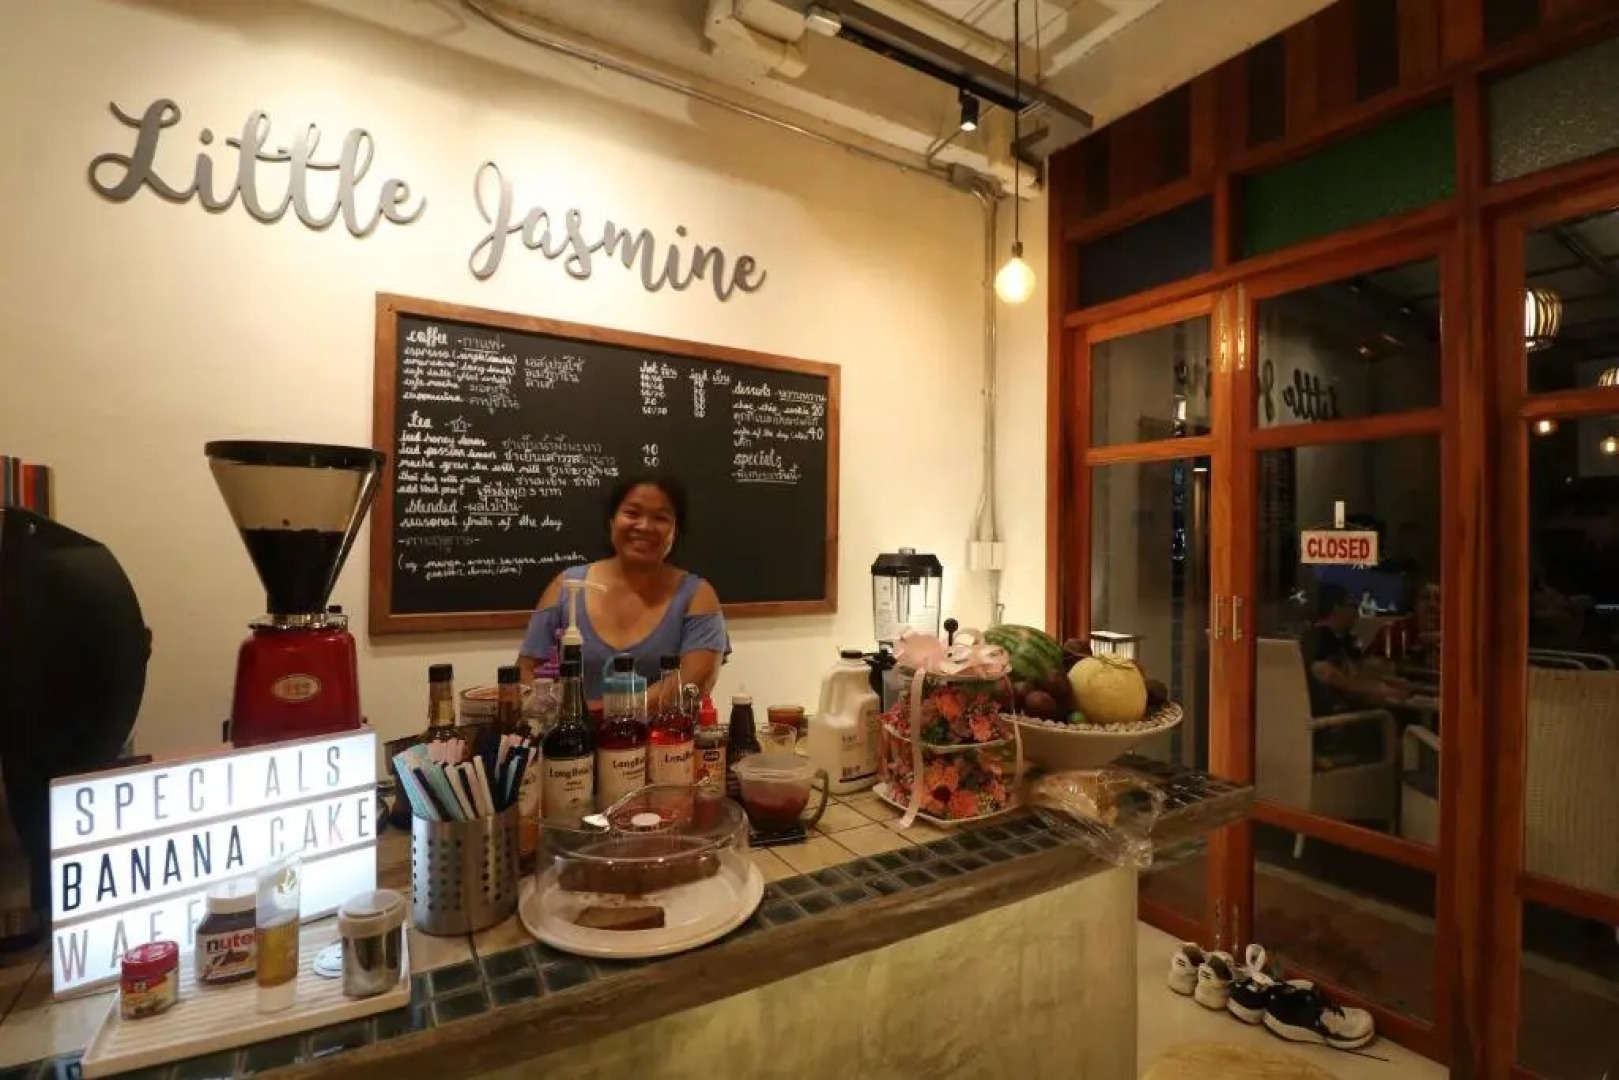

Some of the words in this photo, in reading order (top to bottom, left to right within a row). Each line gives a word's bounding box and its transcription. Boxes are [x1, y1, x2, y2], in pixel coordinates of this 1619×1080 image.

[88, 98, 427, 237] Little
[468, 161, 767, 302] Jasmine
[405, 498, 458, 513] blended
[400, 516, 457, 527] seasonal
[541, 515, 564, 531] day
[1307, 538, 1370, 558] CLOSED
[75, 746, 340, 835] SPECIALS
[62, 825, 244, 911] BANANA
[269, 798, 370, 859] CAKE
[206, 933, 255, 952] nute
